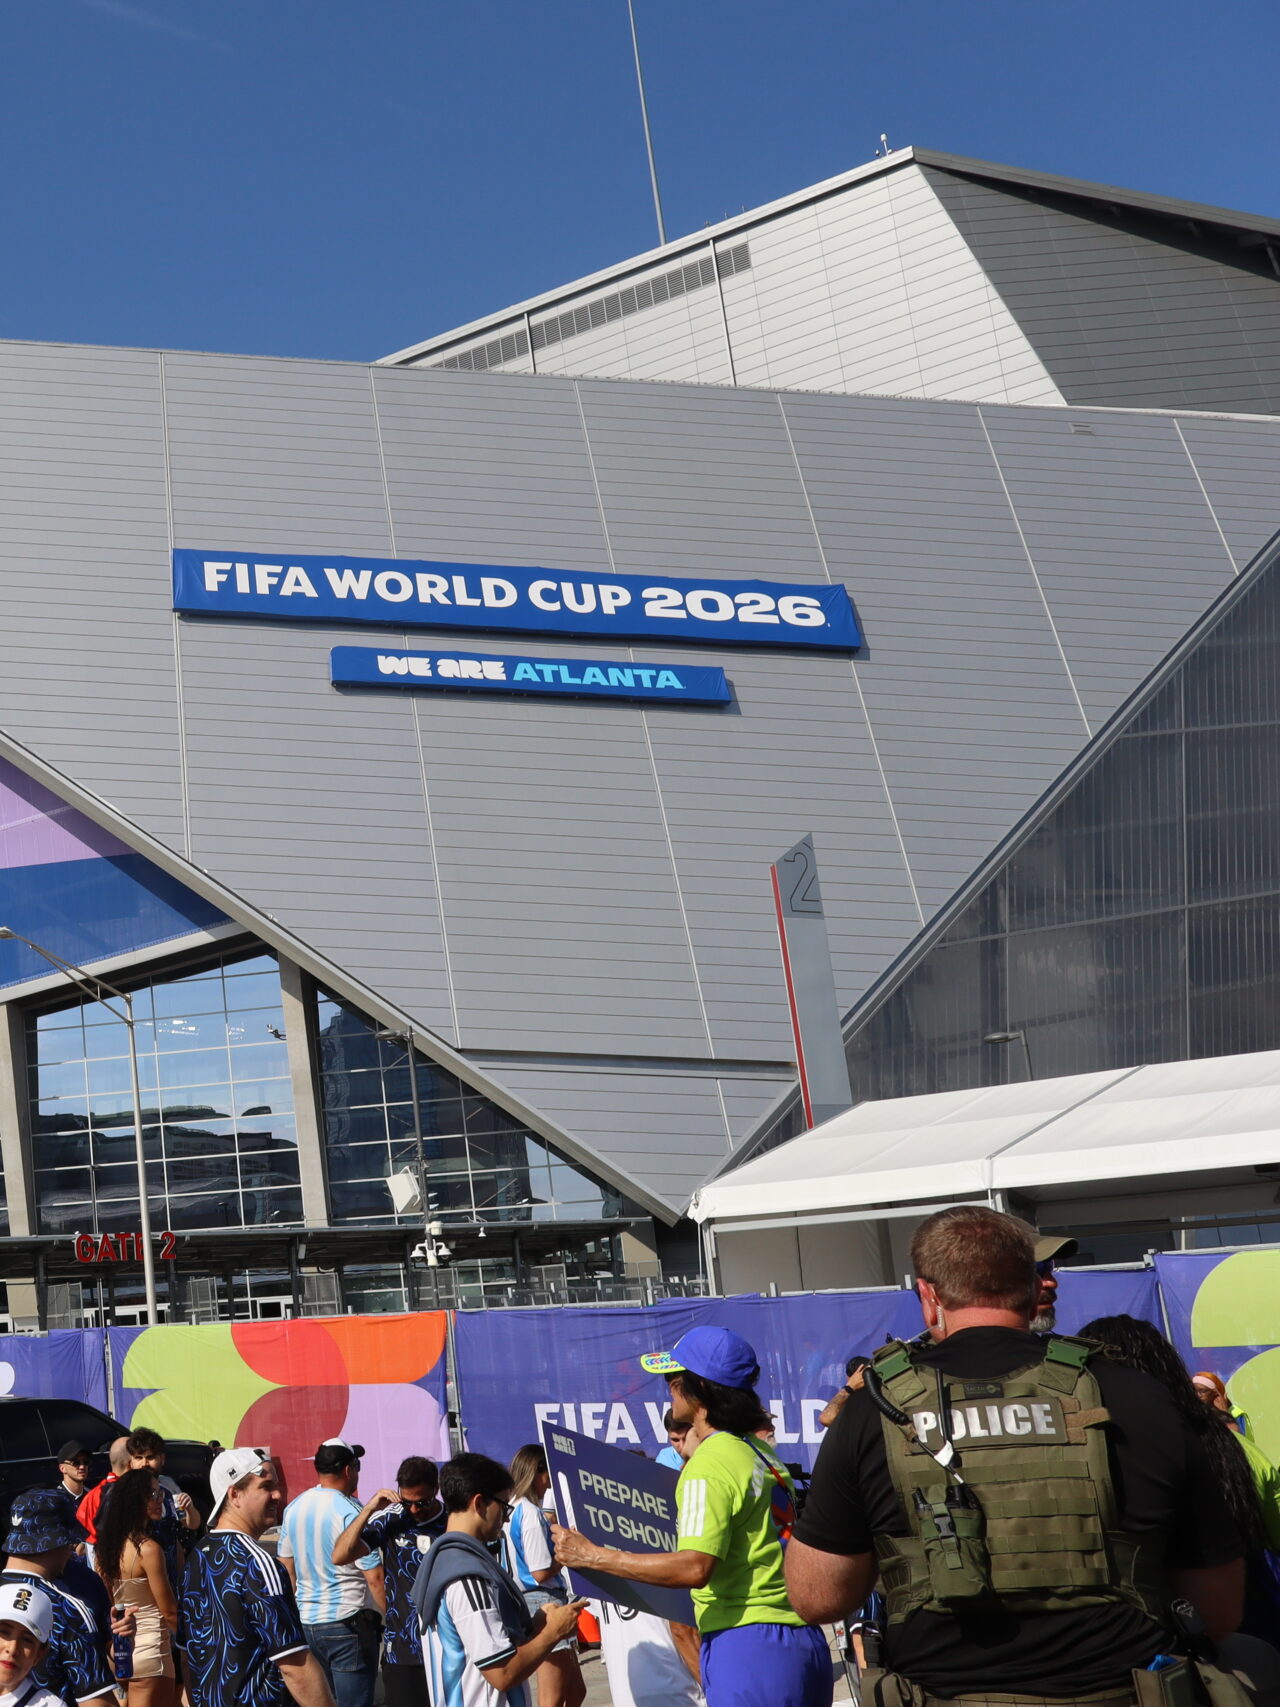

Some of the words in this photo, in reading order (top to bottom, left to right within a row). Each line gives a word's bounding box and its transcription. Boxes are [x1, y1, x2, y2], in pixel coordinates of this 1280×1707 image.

[203, 561, 318, 597] FIFA
[323, 568, 518, 608] WORLD
[528, 579, 631, 615] CUP
[642, 588, 825, 628] 2026
[376, 655, 431, 677] WE
[512, 663, 683, 690] ATLANTA
[160, 1231, 177, 1260] 2
[534, 1402, 642, 1444] FIFA
[912, 1403, 1057, 1444] POLICE
[578, 1468, 672, 1521] PREPARE
[584, 1503, 615, 1534] TO
[616, 1515, 677, 1552] SHOW
